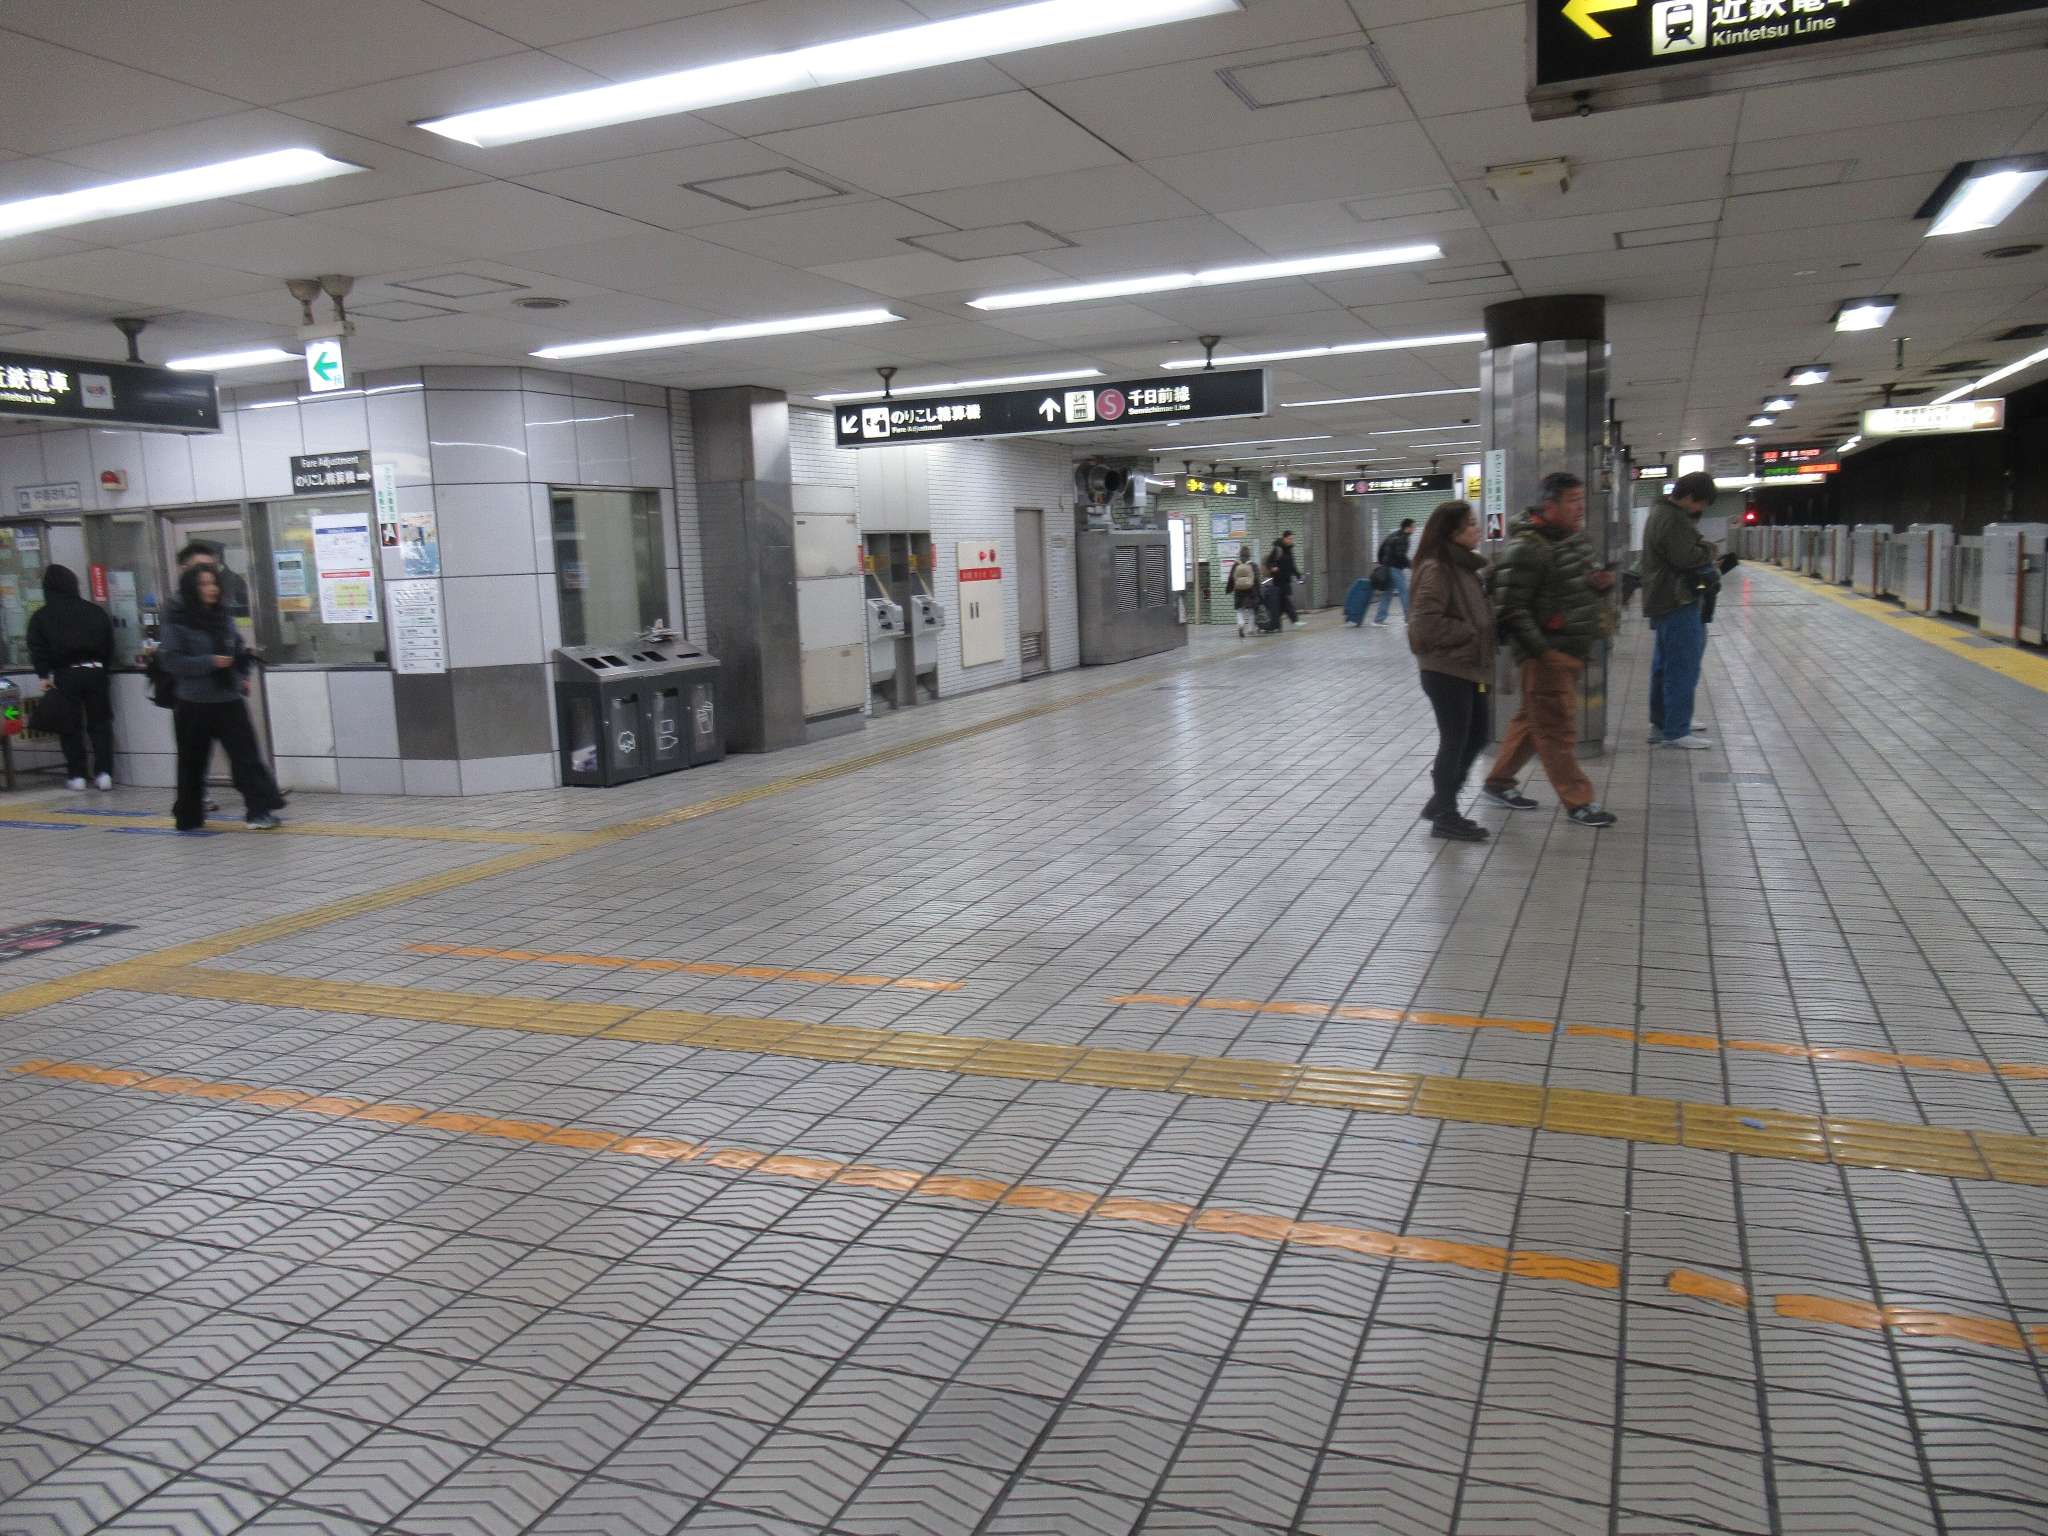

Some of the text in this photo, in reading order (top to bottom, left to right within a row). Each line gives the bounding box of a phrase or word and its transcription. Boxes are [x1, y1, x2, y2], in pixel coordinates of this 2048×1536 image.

[1711, 0, 1850, 26] 近鉄
[1712, 16, 1836, 46] Kintetsu Line
[1127, 385, 1190, 407] 千日前線
[302, 456, 359, 468] Fare Adjustment
